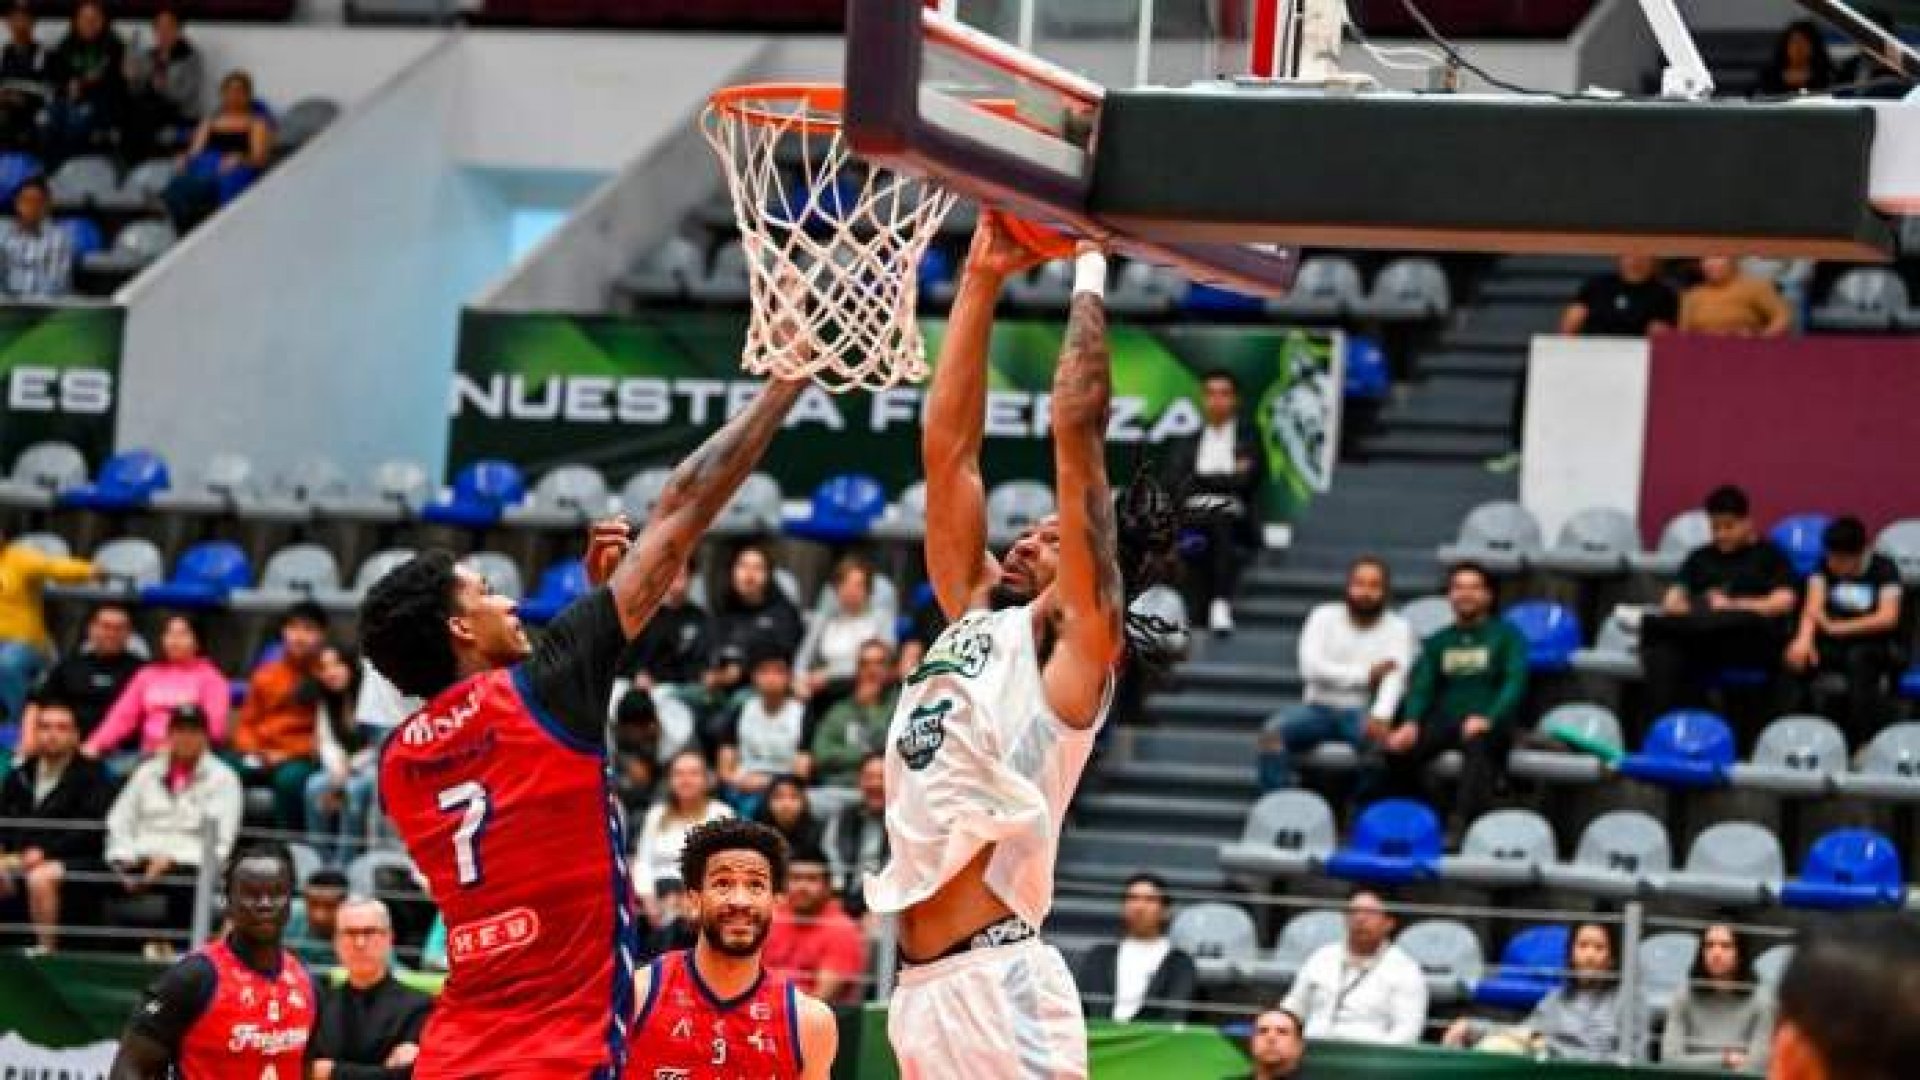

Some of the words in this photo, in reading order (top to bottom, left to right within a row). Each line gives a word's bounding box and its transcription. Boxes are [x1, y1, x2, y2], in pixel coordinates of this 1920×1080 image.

[9, 366, 112, 413] ES
[869, 387, 1202, 443] FEZA
[437, 780, 489, 886] 7
